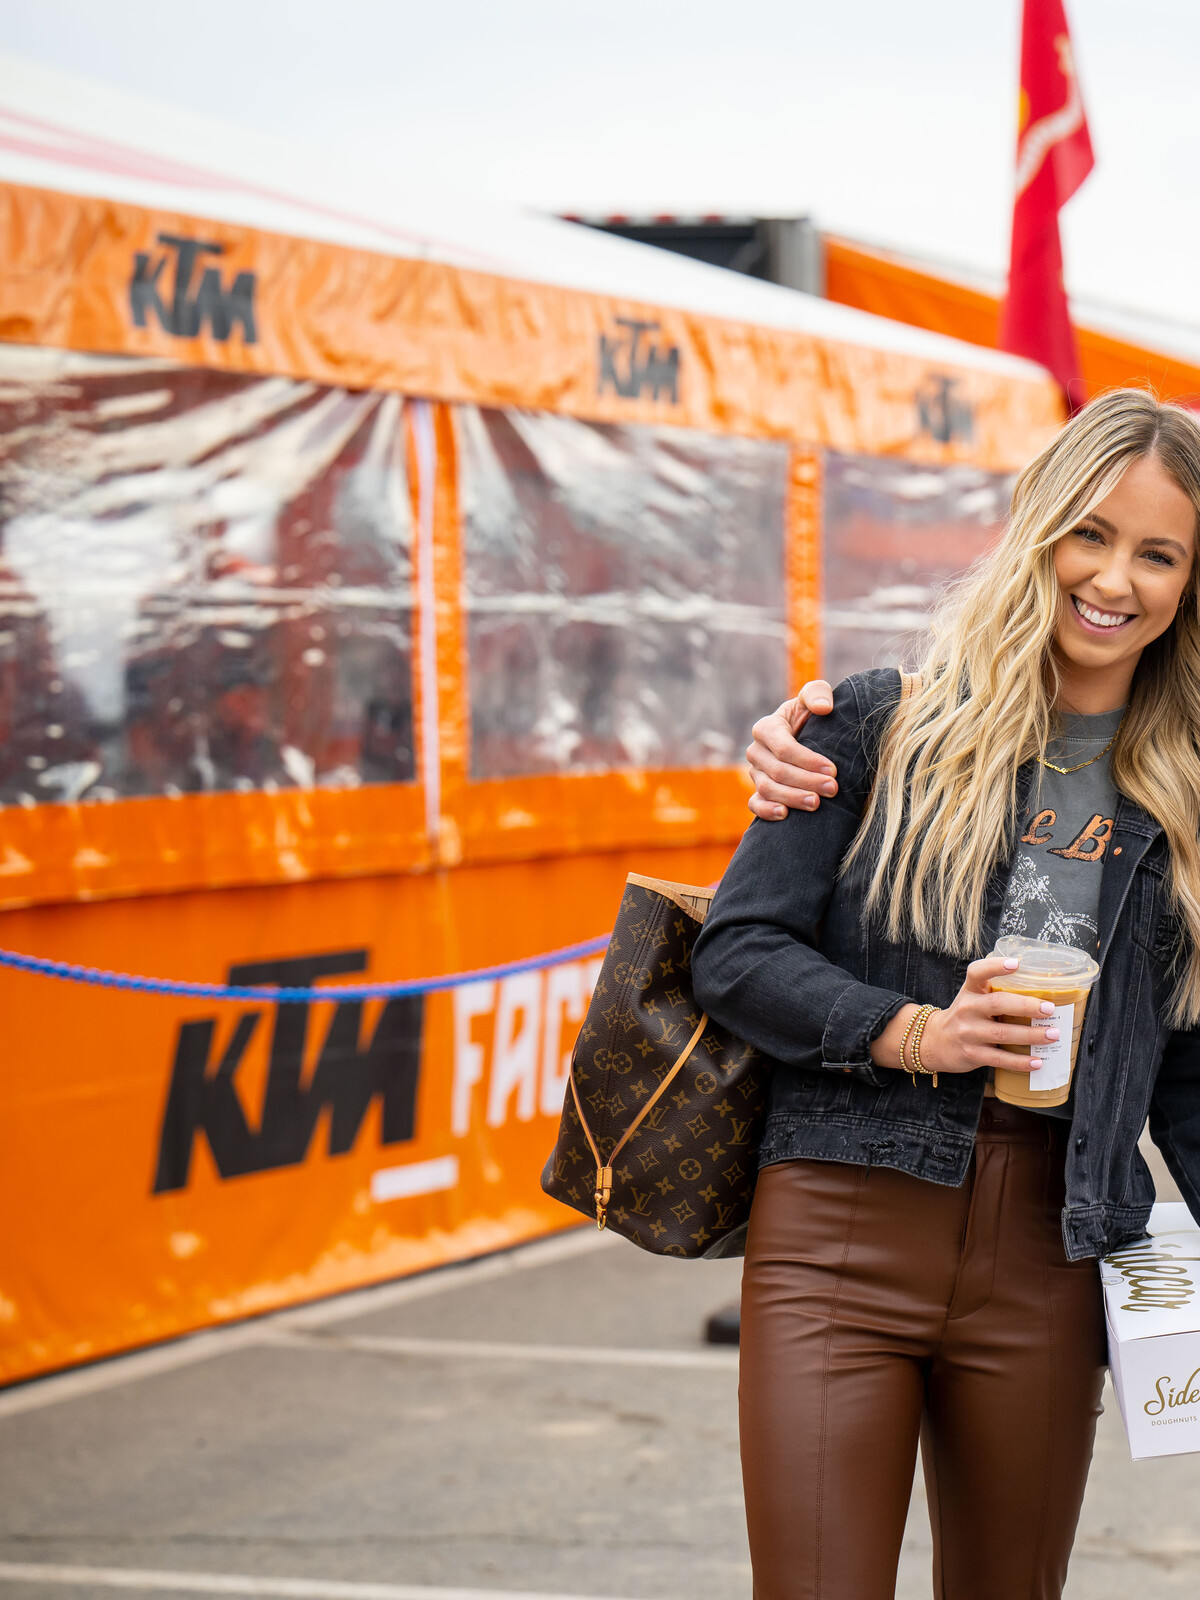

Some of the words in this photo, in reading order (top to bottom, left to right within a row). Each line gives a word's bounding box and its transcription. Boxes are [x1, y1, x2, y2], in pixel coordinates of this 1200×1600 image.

[129, 233, 257, 344] KTM
[599, 317, 681, 403] KTM
[152, 948, 425, 1196] KTM
[1151, 1416, 1197, 1426] DOUGHNUTS
